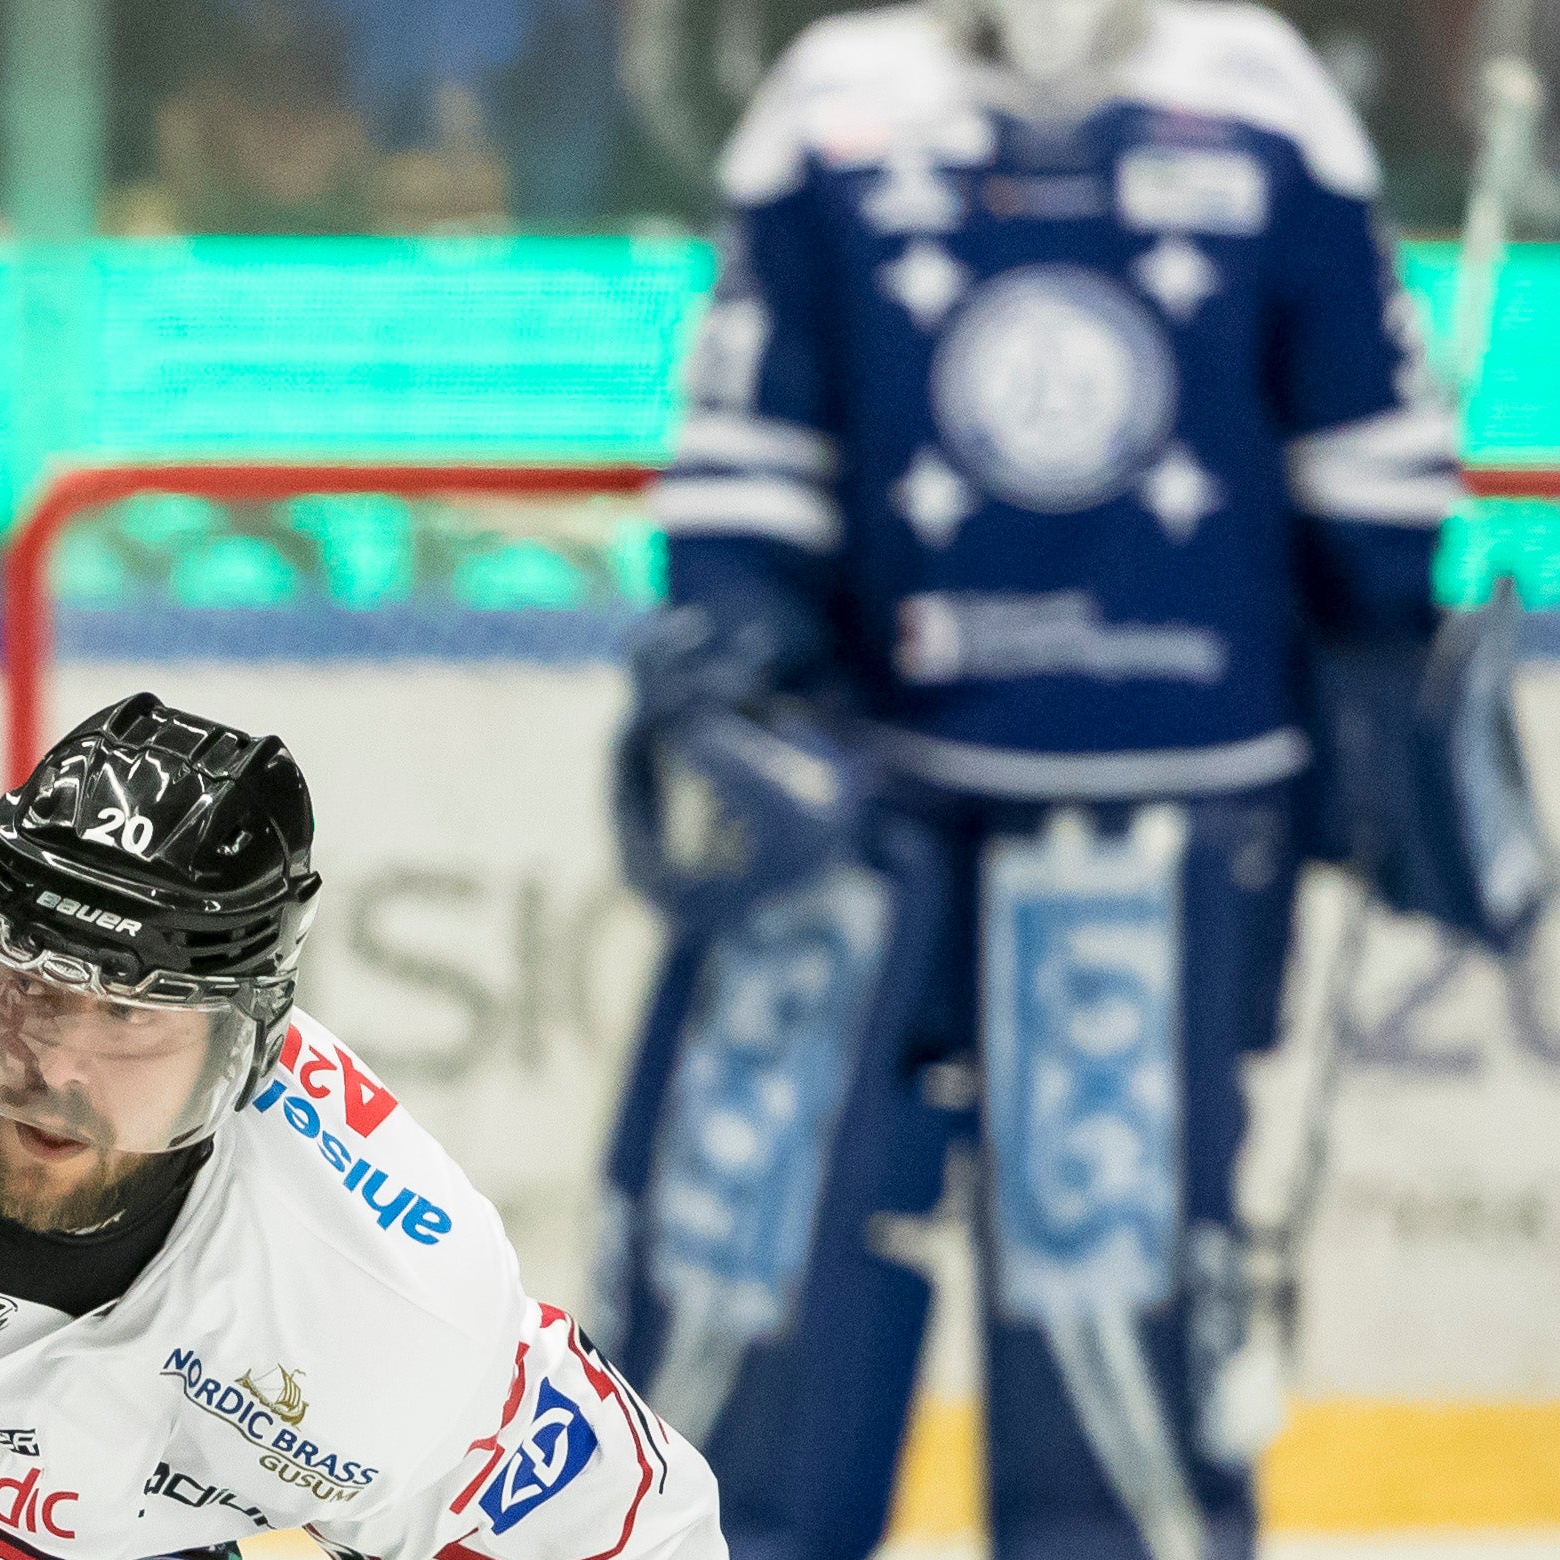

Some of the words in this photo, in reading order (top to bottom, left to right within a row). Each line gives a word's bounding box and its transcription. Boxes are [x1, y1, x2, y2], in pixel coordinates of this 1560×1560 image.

[83, 806, 154, 857] 20
[165, 1347, 273, 1440] NORDIC
[270, 1425, 380, 1489] BRASS
[258, 1451, 361, 1505] GUSUM
